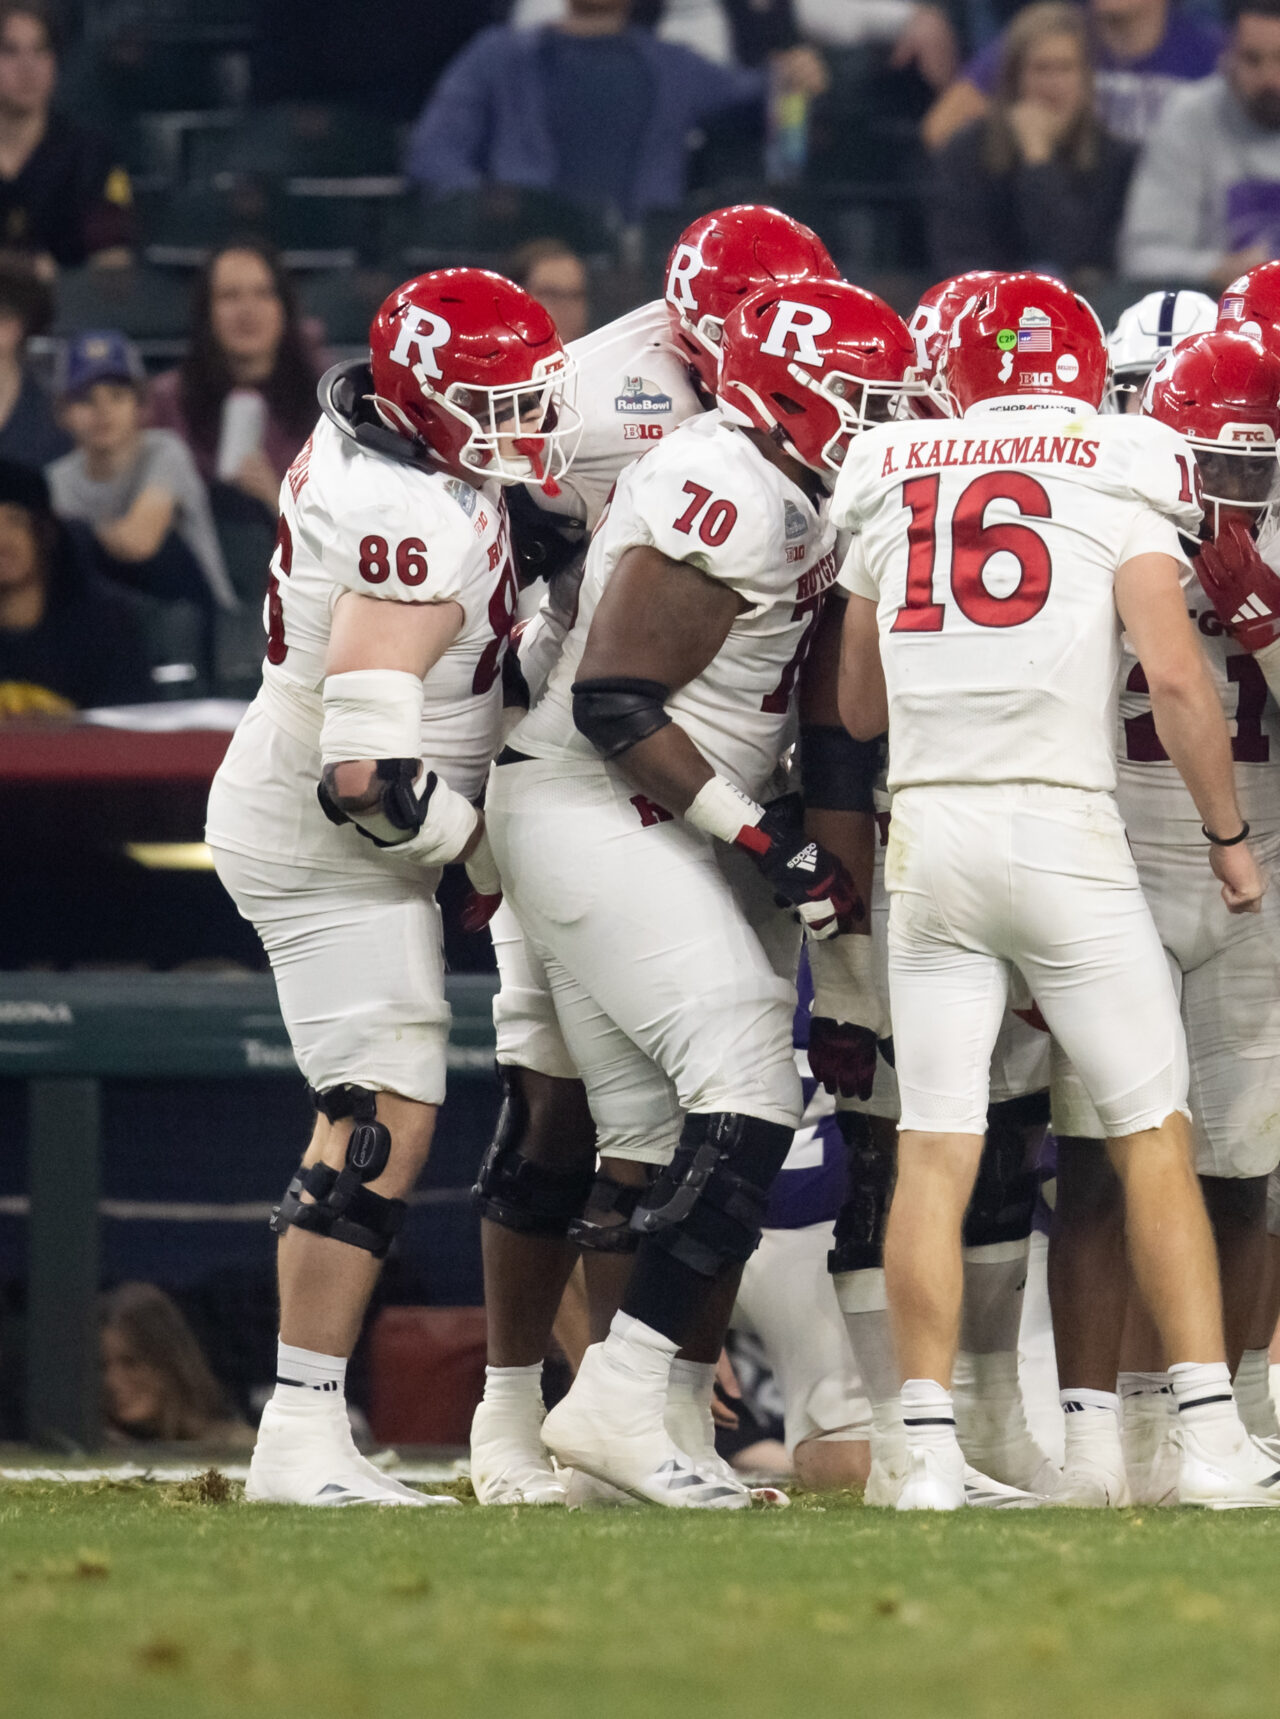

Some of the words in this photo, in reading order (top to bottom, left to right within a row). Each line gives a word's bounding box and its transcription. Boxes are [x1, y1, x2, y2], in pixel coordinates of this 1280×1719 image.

[666, 243, 702, 311] R
[389, 304, 451, 380] R
[760, 300, 832, 367] R
[881, 446, 899, 478] A.
[905, 436, 1100, 469] KALIAKMANIS
[1232, 431, 1265, 441] FTG
[672, 480, 738, 547] 70
[359, 535, 428, 586] 86
[889, 470, 1052, 633] 16
